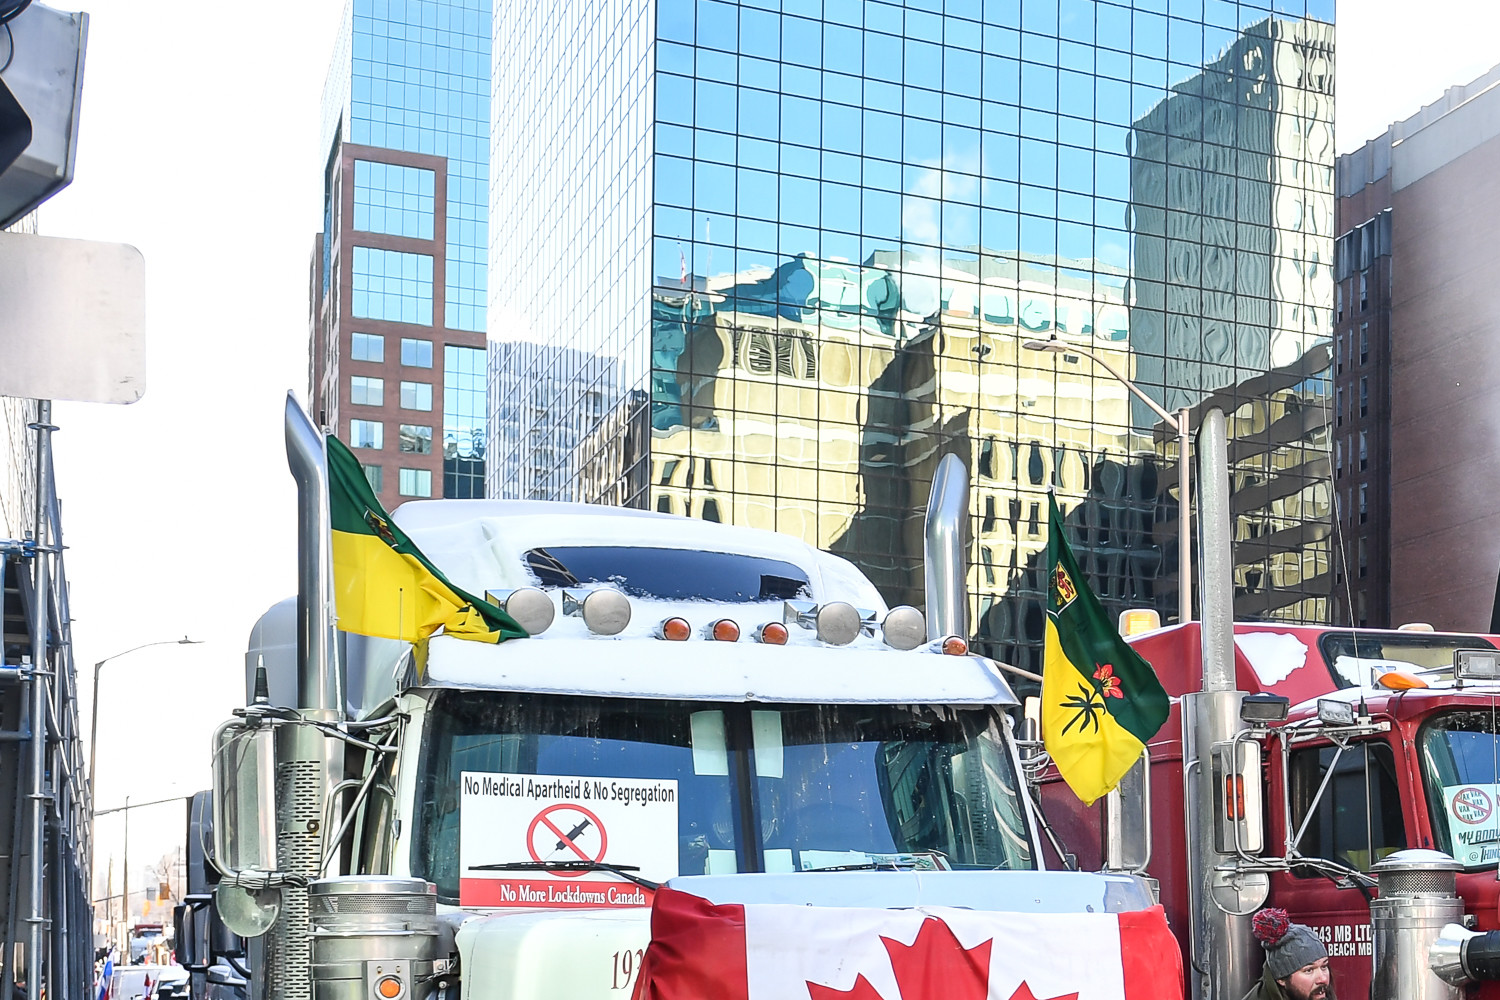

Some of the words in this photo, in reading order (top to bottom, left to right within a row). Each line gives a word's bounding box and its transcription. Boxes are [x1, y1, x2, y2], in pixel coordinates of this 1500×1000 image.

[464, 776, 480, 796] No
[482, 776, 524, 798] Medical
[527, 778, 581, 801] Apartheid
[583, 781, 592, 798] &
[594, 781, 609, 800] No
[611, 782, 675, 807] Segregation
[1459, 830, 1475, 845] MY
[500, 884, 517, 902] No
[518, 885, 546, 903] More
[548, 885, 606, 904] Lockdowns
[607, 886, 646, 905] Canada
[1309, 925, 1332, 943] 543
[1334, 925, 1352, 942] MB
[1328, 942, 1356, 957] BEACH
[1358, 942, 1372, 956] MB
